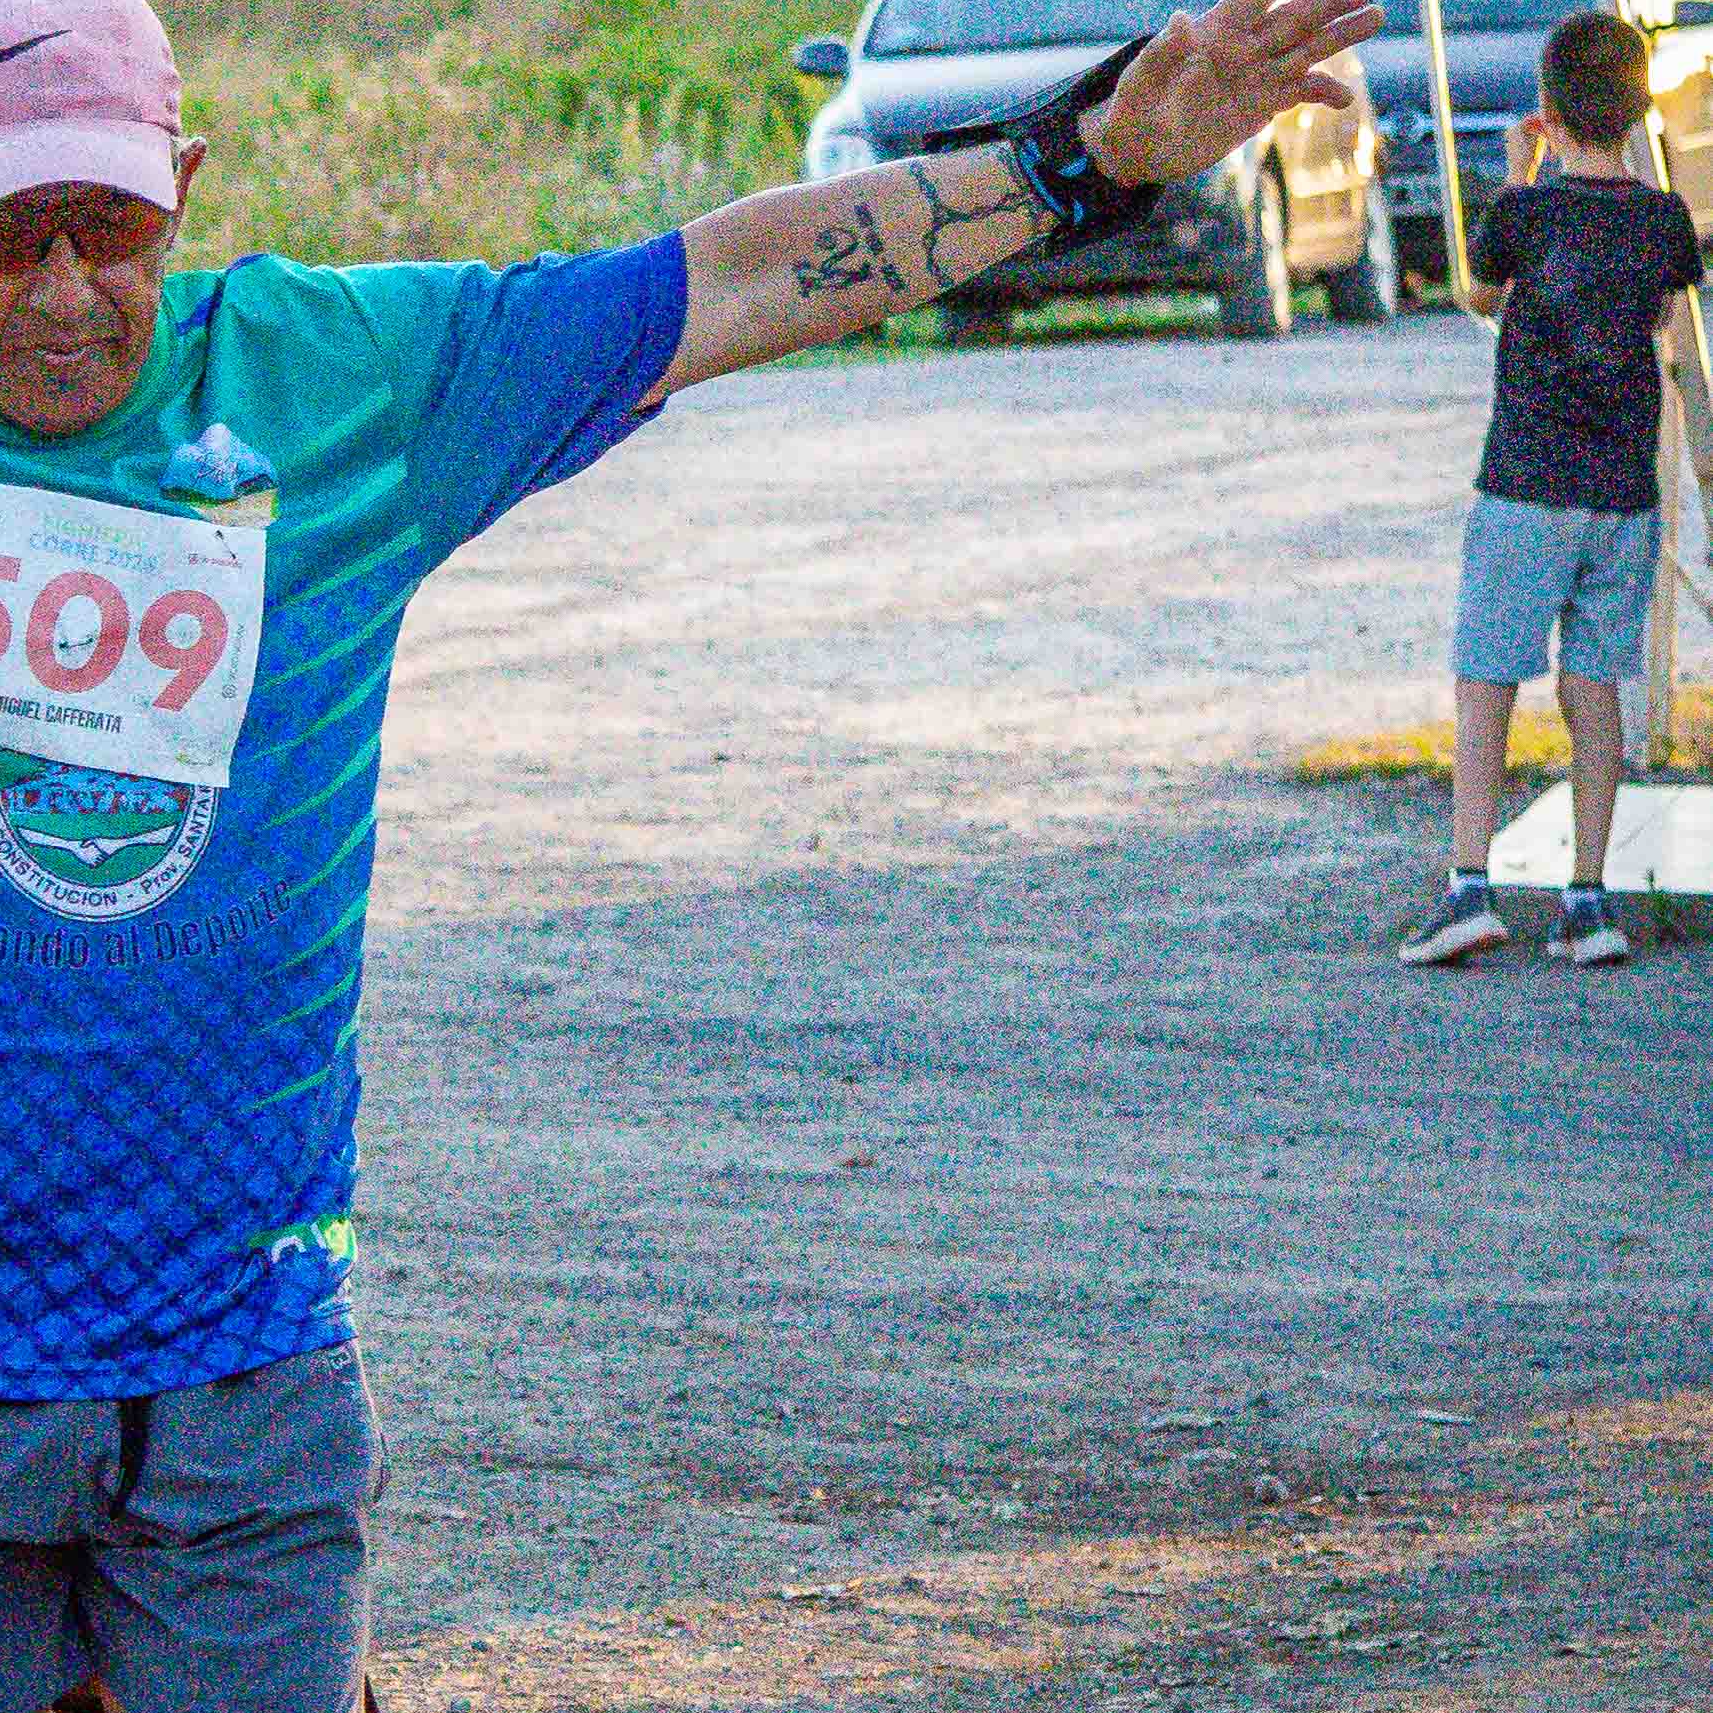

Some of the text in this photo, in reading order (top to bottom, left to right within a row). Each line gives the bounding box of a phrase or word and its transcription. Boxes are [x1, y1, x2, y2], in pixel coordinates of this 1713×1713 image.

[45, 704, 123, 734] CAFFERATA
[179, 799, 211, 858] SANTA
[104, 926, 140, 966] al
[154, 878, 290, 961] Deporte
